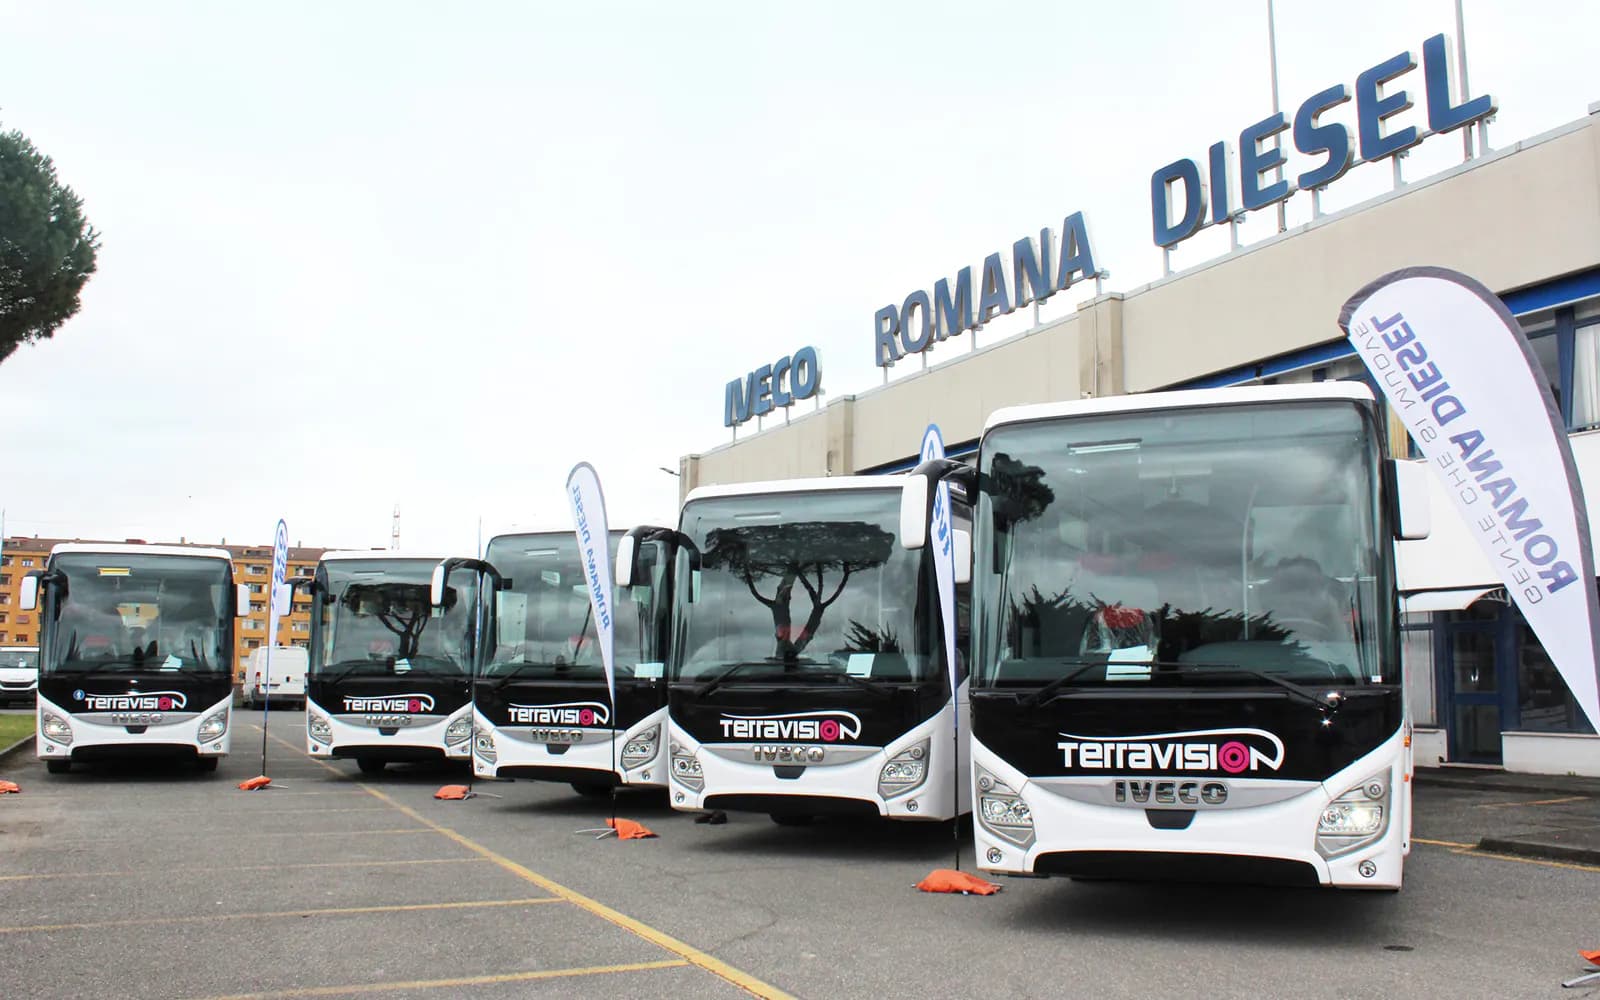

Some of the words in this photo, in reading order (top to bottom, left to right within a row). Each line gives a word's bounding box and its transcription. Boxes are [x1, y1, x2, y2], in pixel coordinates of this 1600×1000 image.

[724, 345, 821, 427] IVECO
[874, 210, 1098, 367] ROMANA
[1150, 32, 1499, 247] DIESEL
[753, 745, 825, 762] IVECO
[1113, 779, 1230, 805] IVECO
